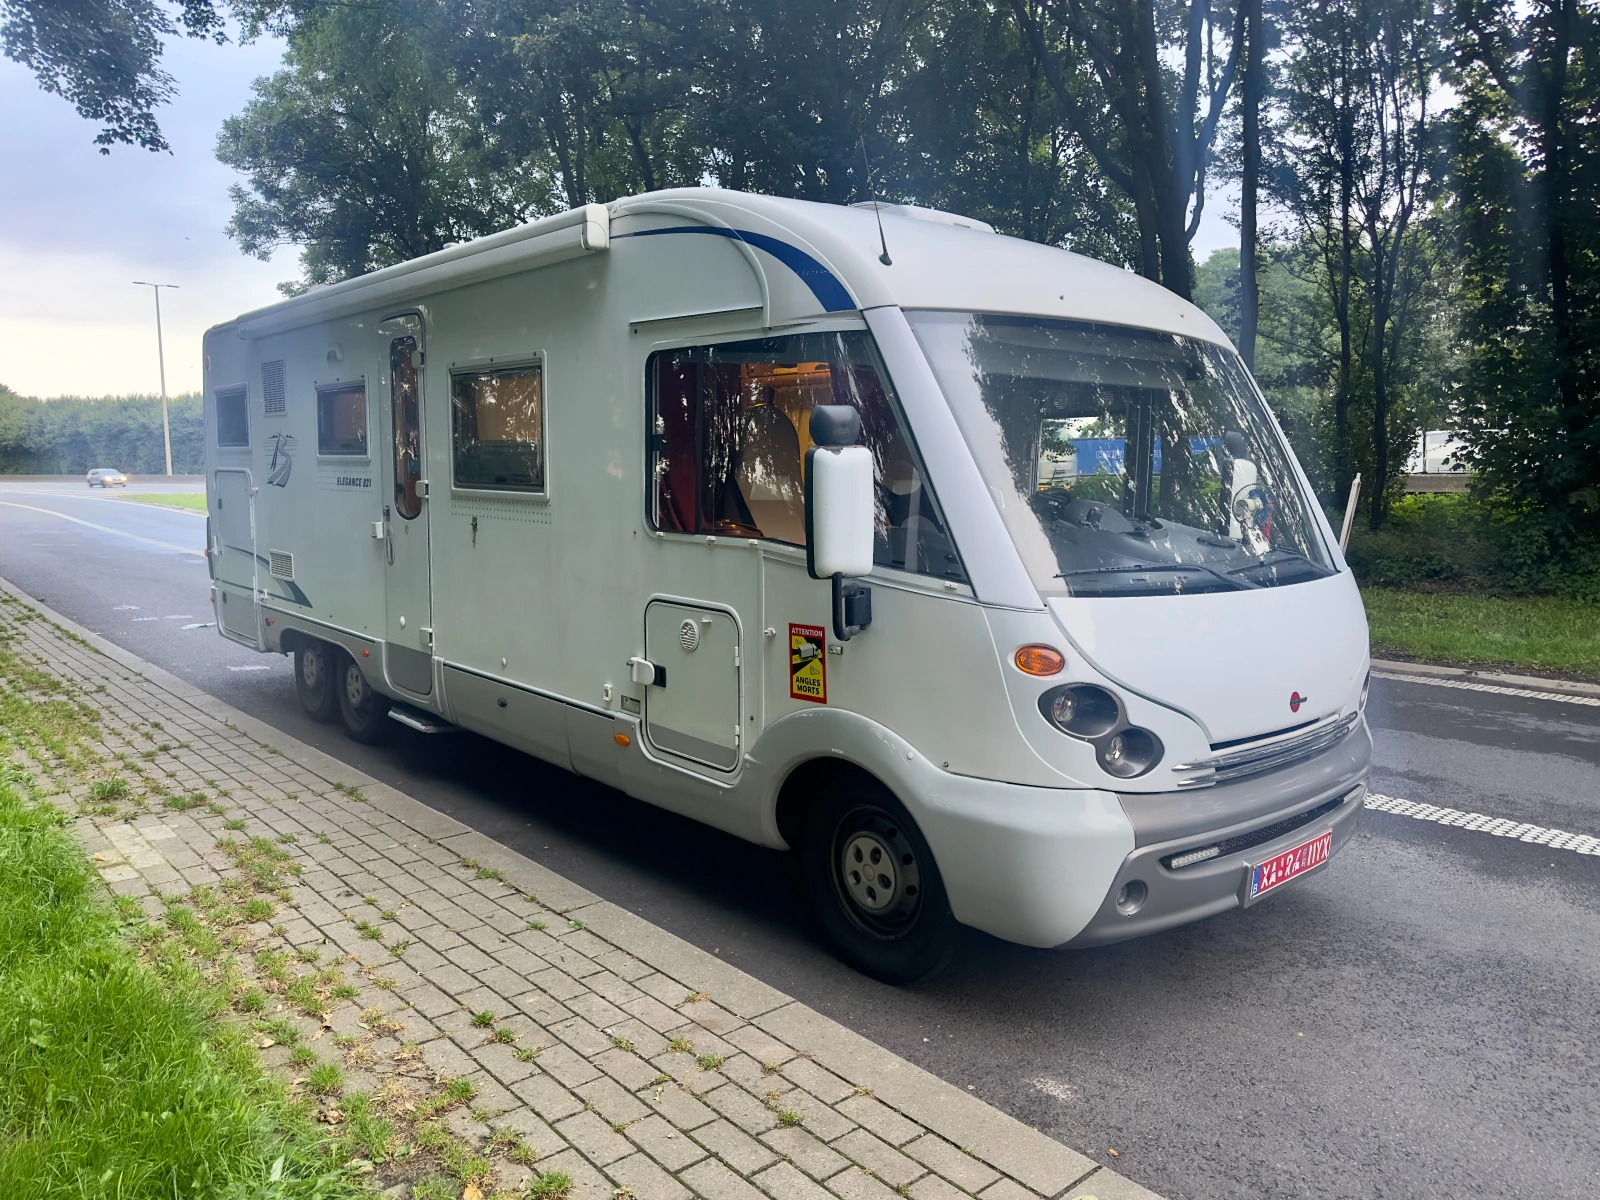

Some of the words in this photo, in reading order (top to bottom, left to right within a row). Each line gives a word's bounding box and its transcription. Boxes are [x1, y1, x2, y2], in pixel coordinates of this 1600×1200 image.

[336, 476, 363, 487] ELEGANCE
[791, 627, 823, 638] ATTENTION
[795, 675, 821, 688] ANGLES
[796, 684, 820, 696] MORTS
